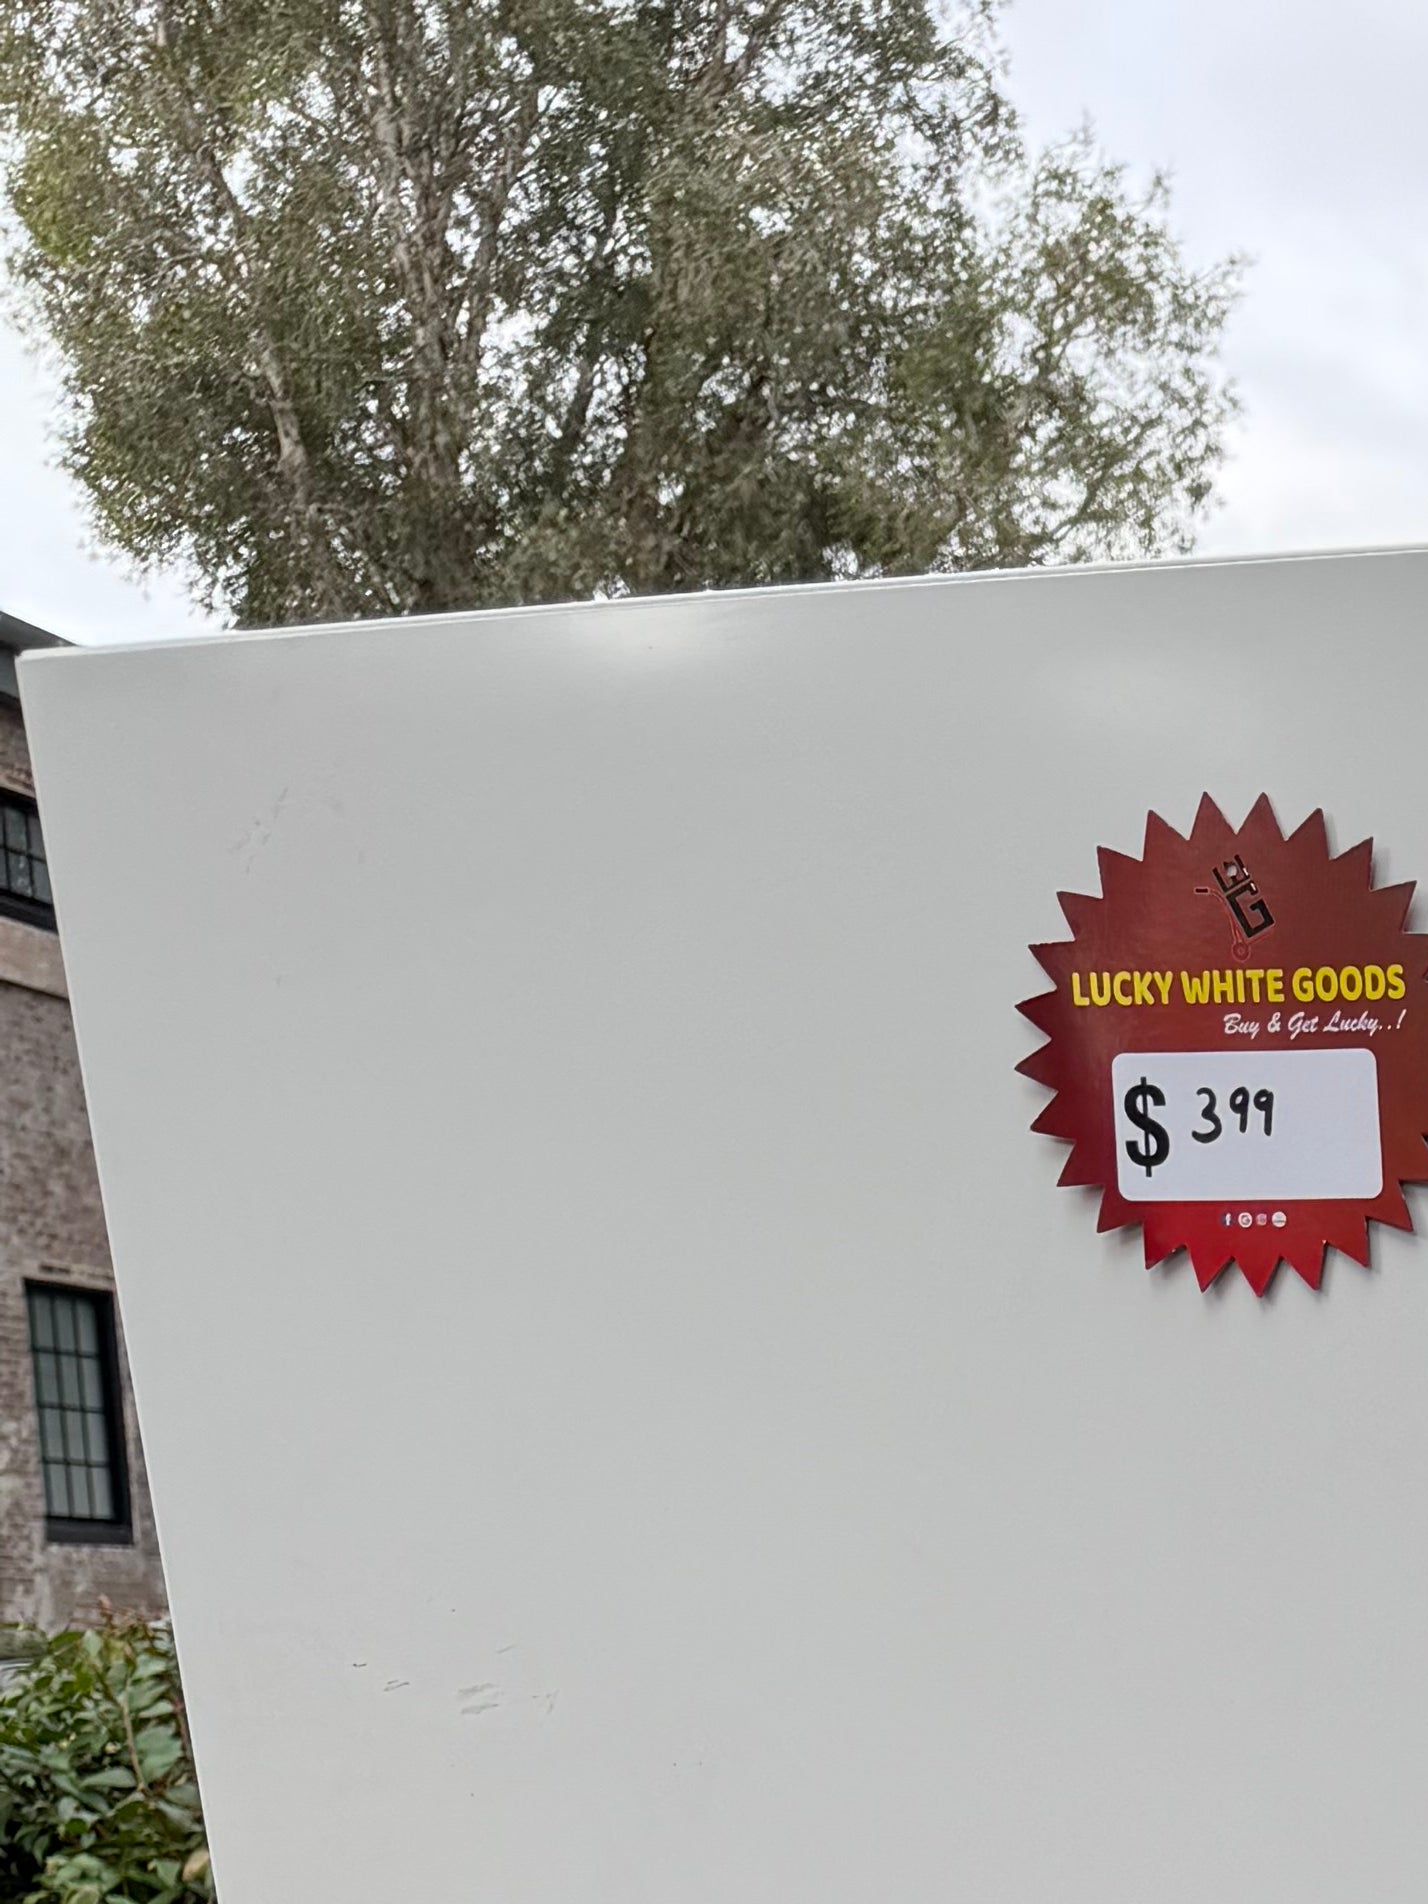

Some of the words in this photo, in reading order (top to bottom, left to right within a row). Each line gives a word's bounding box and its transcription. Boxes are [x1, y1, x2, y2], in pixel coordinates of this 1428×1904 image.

[1072, 971, 1173, 1007] LUCKY
[1181, 968, 1284, 1004] WHITE
[1293, 964, 1406, 1002] GOODS
[1223, 1013, 1259, 1037] Buy
[1268, 1014, 1281, 1034] &
[1288, 1012, 1319, 1039] Get
[1191, 1086, 1276, 1144] 399
